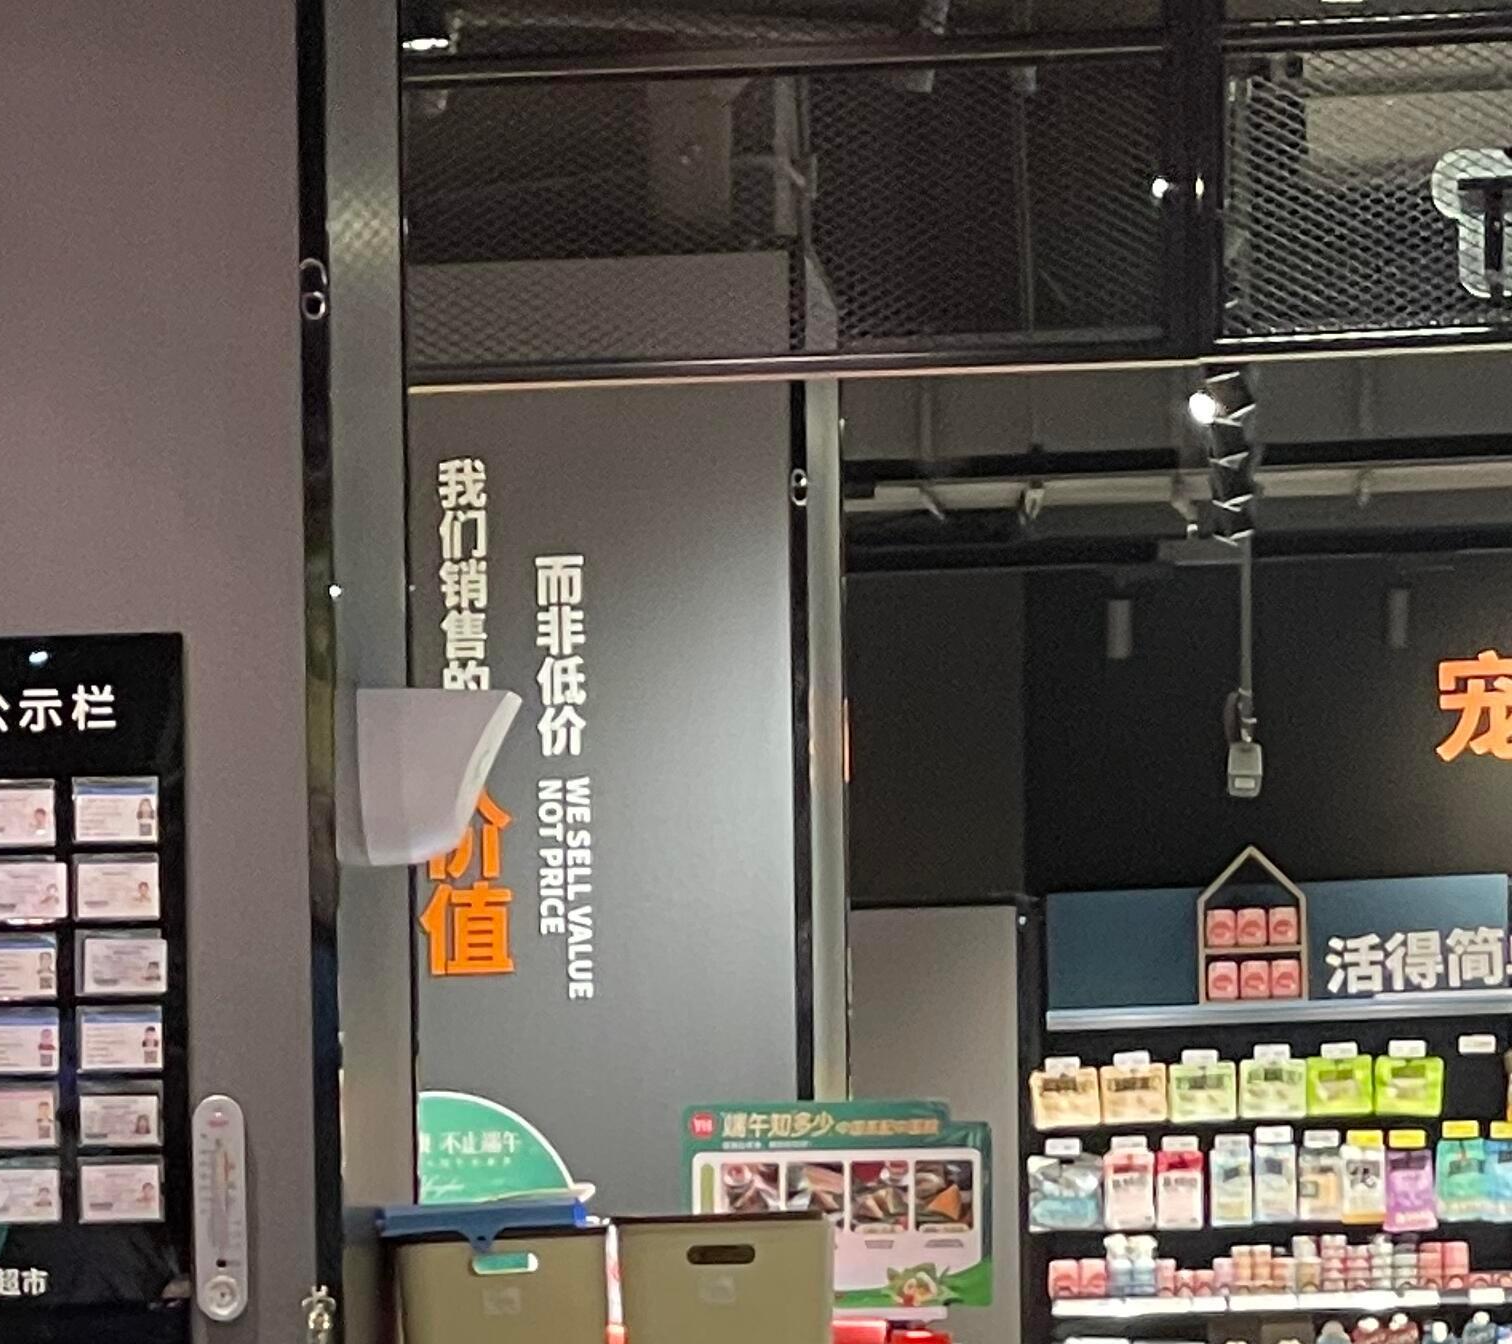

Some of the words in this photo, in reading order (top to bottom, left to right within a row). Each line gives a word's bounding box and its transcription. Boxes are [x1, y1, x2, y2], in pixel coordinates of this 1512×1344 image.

[534, 554, 588, 756] 而非低价
[538, 779, 564, 841] NOT
[566, 776, 591, 823] WE
[539, 848, 566, 936] PRICE
[567, 830, 592, 901] SELL
[568, 905, 594, 1000] VALUE
[1325, 926, 1512, 994] 活得简
[719, 1110, 835, 1138] 端午知多少
